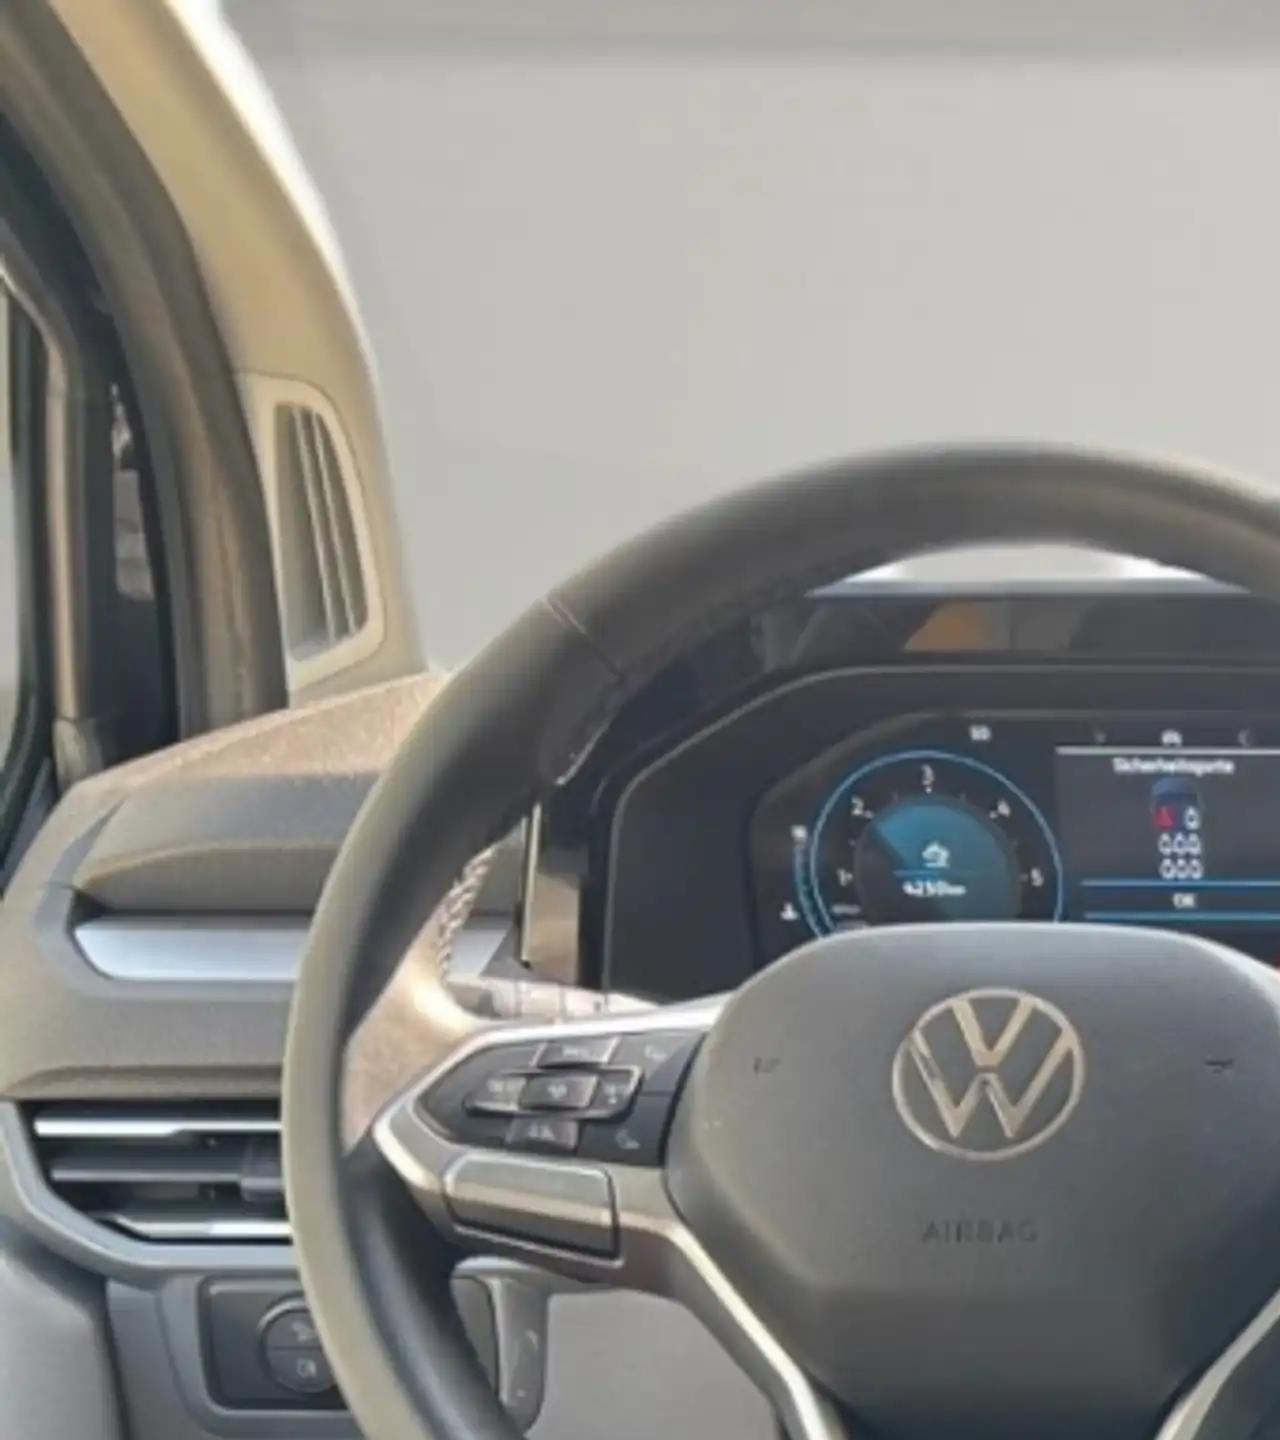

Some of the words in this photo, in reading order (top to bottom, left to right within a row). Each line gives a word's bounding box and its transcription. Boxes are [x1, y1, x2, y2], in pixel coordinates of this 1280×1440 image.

[851, 797, 866, 817] 2
[1030, 868, 1044, 888] 5
[922, 1220, 1040, 1245] AIRBAG
